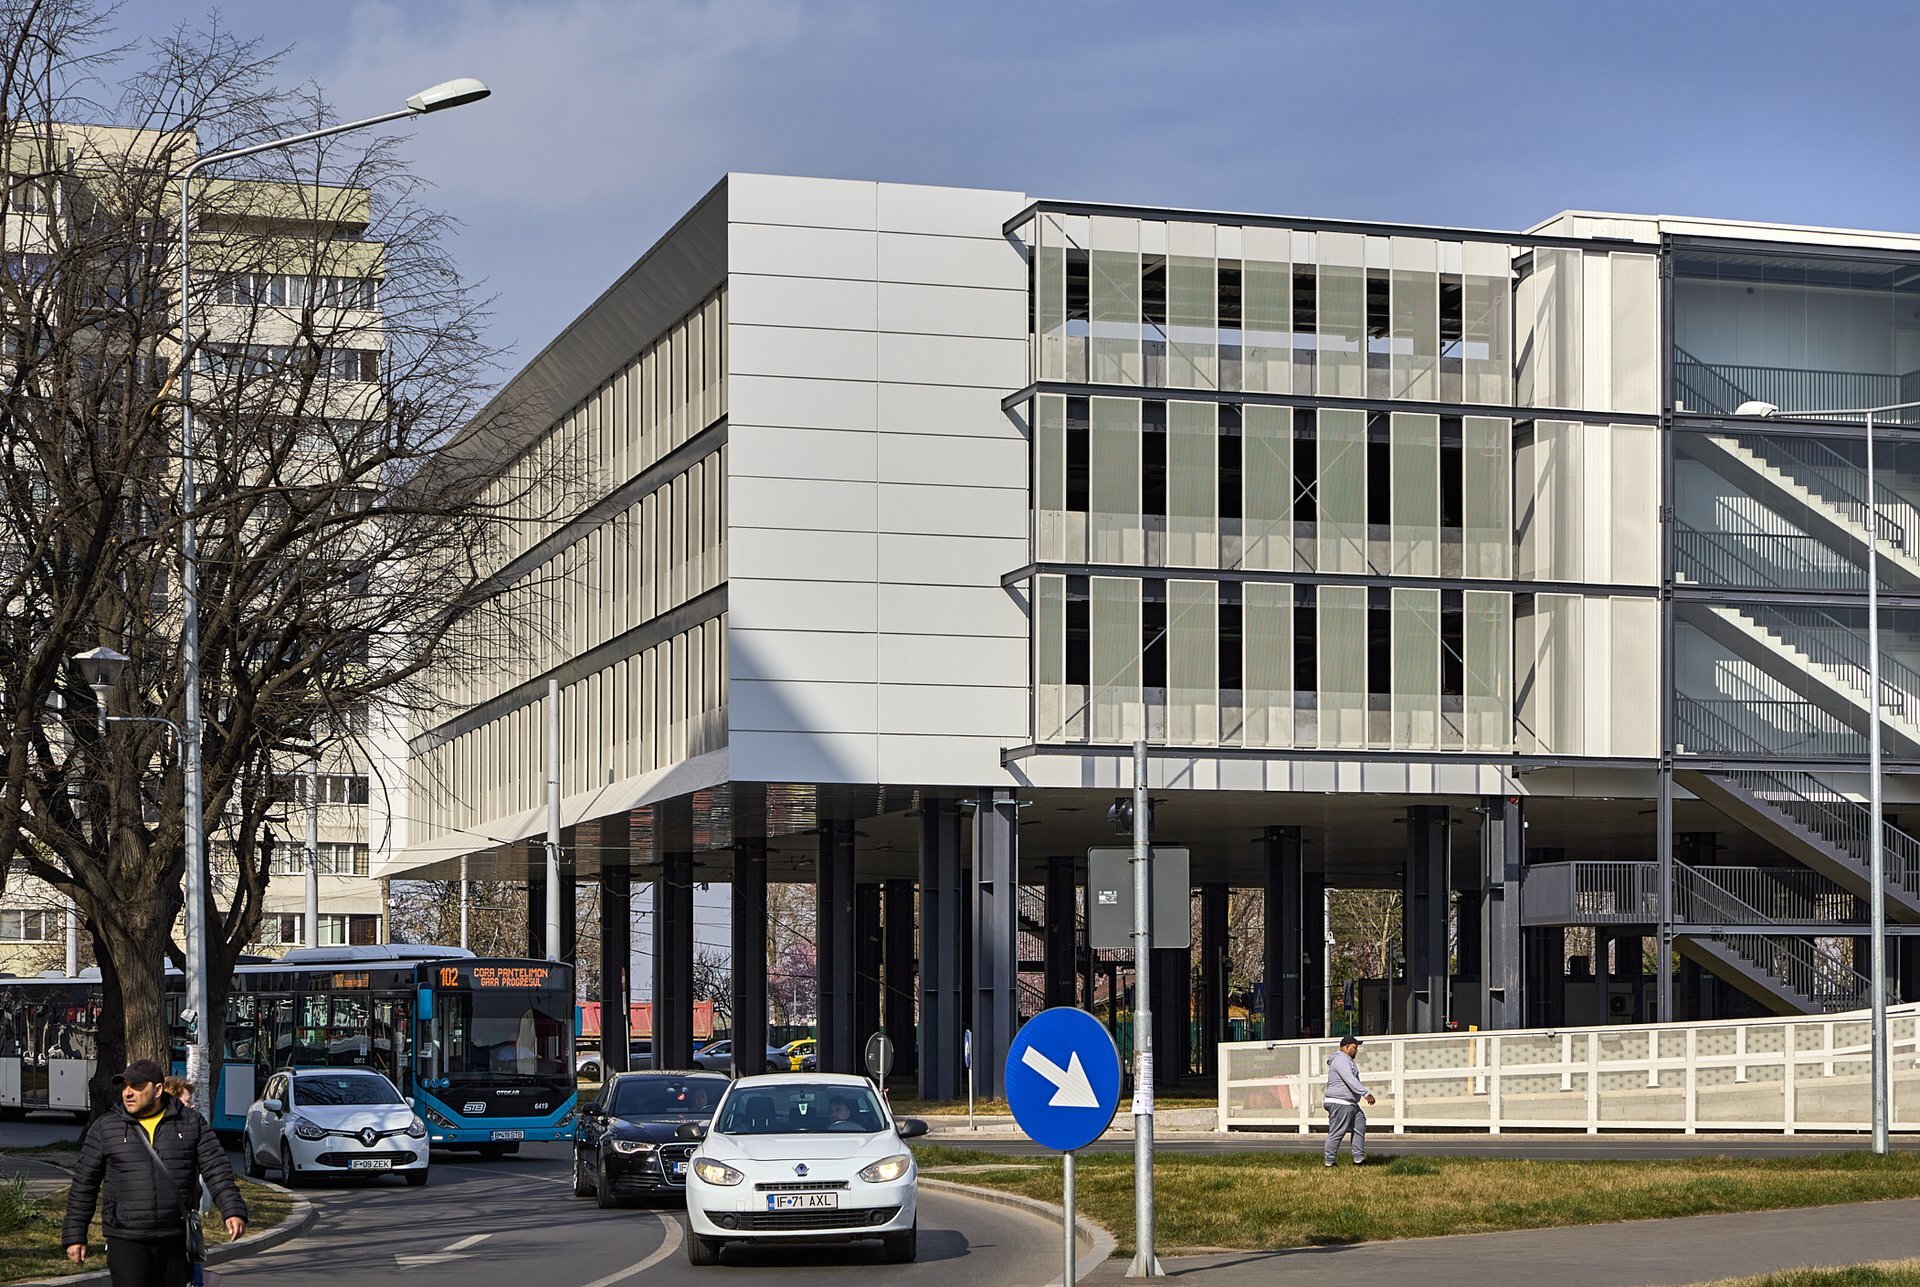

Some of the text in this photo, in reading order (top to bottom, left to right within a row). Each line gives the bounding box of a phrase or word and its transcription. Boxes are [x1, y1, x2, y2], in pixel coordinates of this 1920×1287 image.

[440, 967, 459, 987] 102
[473, 967, 549, 978] CORA PANTELIMON
[480, 977, 542, 987] GARA PROGRESUL
[463, 1103, 484, 1111] STB
[534, 1102, 549, 1110] 6419
[373, 1160, 389, 1168] ZEK
[776, 1194, 832, 1208] IF 71 AXL
